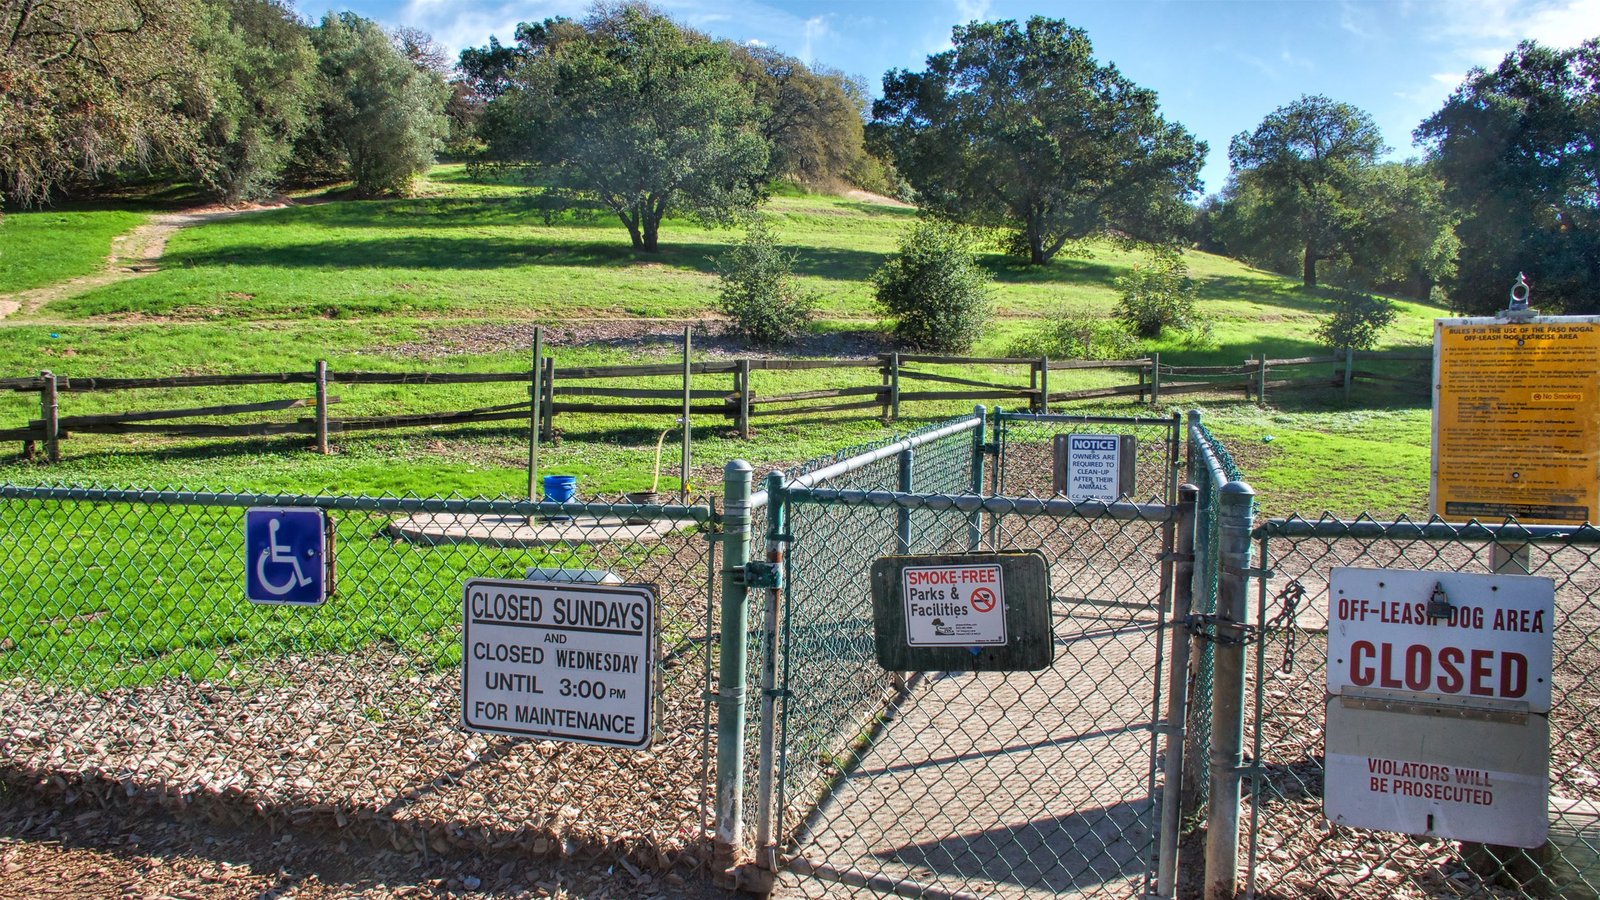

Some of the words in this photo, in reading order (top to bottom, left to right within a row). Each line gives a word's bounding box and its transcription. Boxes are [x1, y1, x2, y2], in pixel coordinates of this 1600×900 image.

[1074, 440, 1114, 450] NOTICE
[908, 569, 996, 585] SMOKE-FREE
[910, 587, 945, 601] Parks
[950, 587, 959, 600] &
[472, 592, 543, 622] CLOSED
[553, 598, 644, 630] SUNDAYS
[911, 603, 968, 617] Facilities
[1447, 606, 1483, 630] DOG
[1493, 608, 1544, 633] AREA
[544, 633, 567, 644] AND
[474, 642, 544, 665] CLOSED
[556, 649, 639, 674] WEDNESDAY
[1349, 640, 1528, 699] CLOSED
[485, 672, 543, 694] UNTIL
[559, 679, 606, 700] 3:00
[609, 688, 626, 699] PM
[475, 701, 507, 721] FOR
[515, 705, 635, 735] MAINTENANCE
[1368, 758, 1450, 782] VIOLATORS
[1455, 768, 1493, 787] WILL
[1370, 776, 1388, 793] BE
[1393, 779, 1493, 806] PROSECUTED
